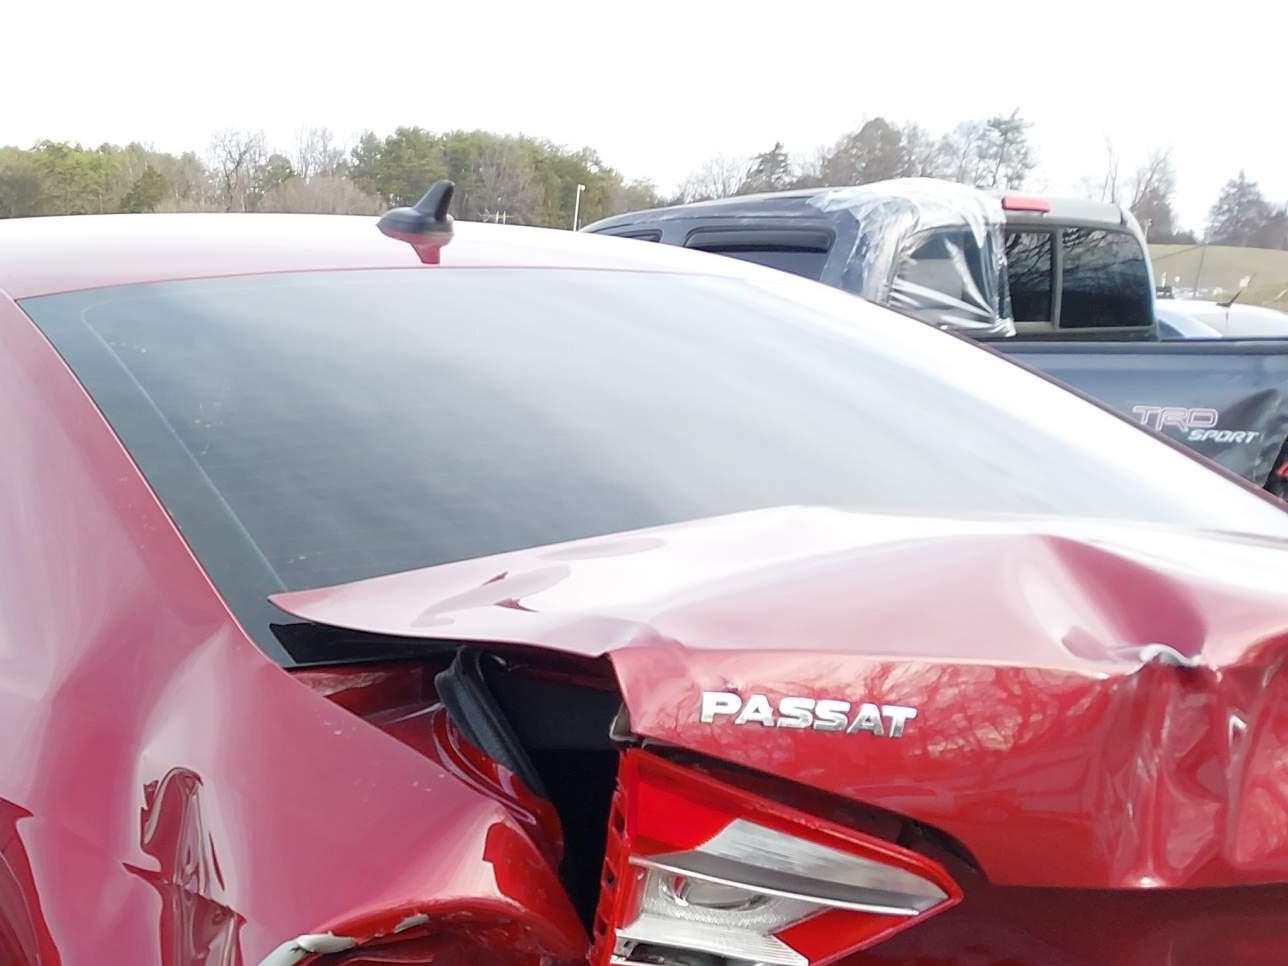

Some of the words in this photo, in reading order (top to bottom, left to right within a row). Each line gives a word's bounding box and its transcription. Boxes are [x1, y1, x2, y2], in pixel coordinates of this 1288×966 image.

[1132, 405, 1219, 433] TRD
[1187, 429, 1260, 444] SPORT
[700, 690, 918, 738] PASSAT
